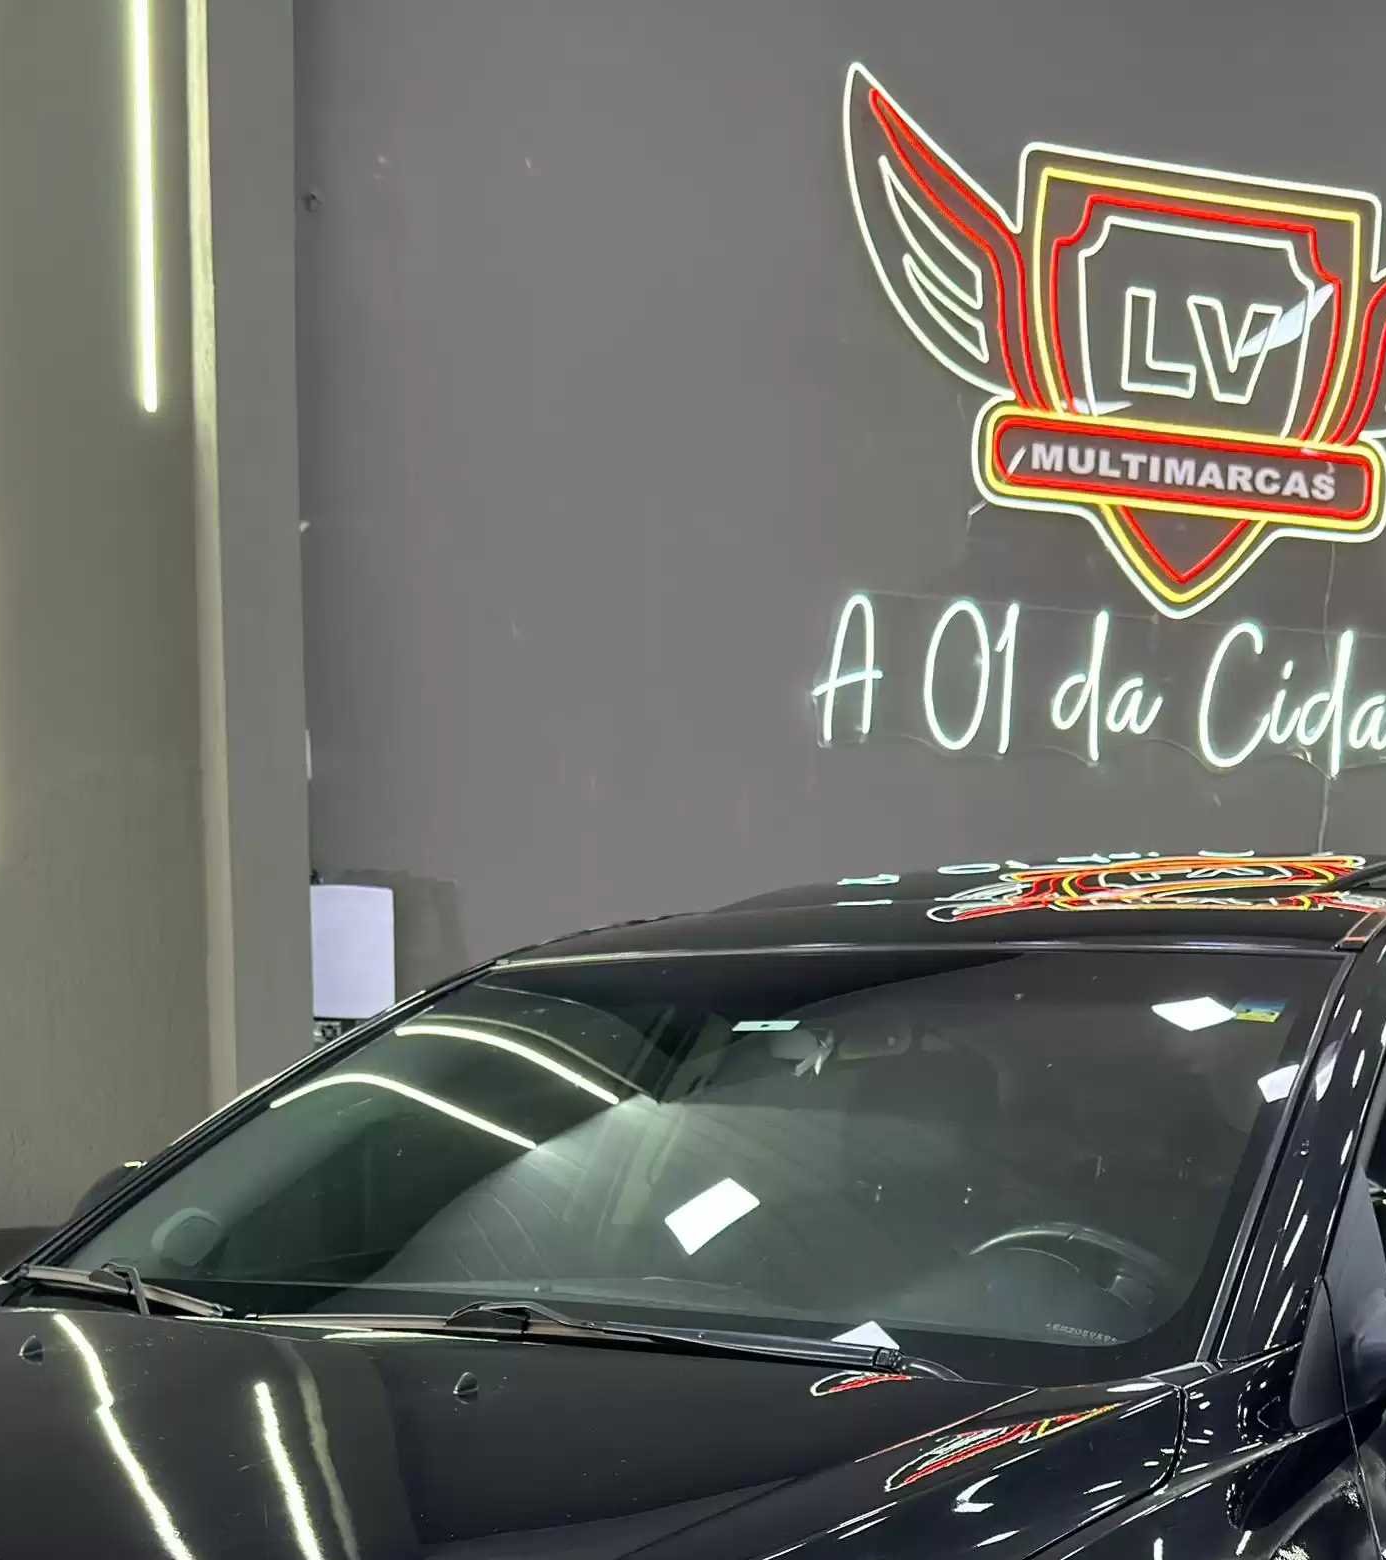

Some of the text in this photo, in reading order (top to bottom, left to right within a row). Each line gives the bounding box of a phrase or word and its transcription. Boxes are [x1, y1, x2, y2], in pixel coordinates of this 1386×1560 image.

[1121, 287, 1282, 404] LV
[1030, 441, 1337, 502] MULTIMARCAS
[813, 594, 883, 748] A
[1051, 611, 1164, 763] da
